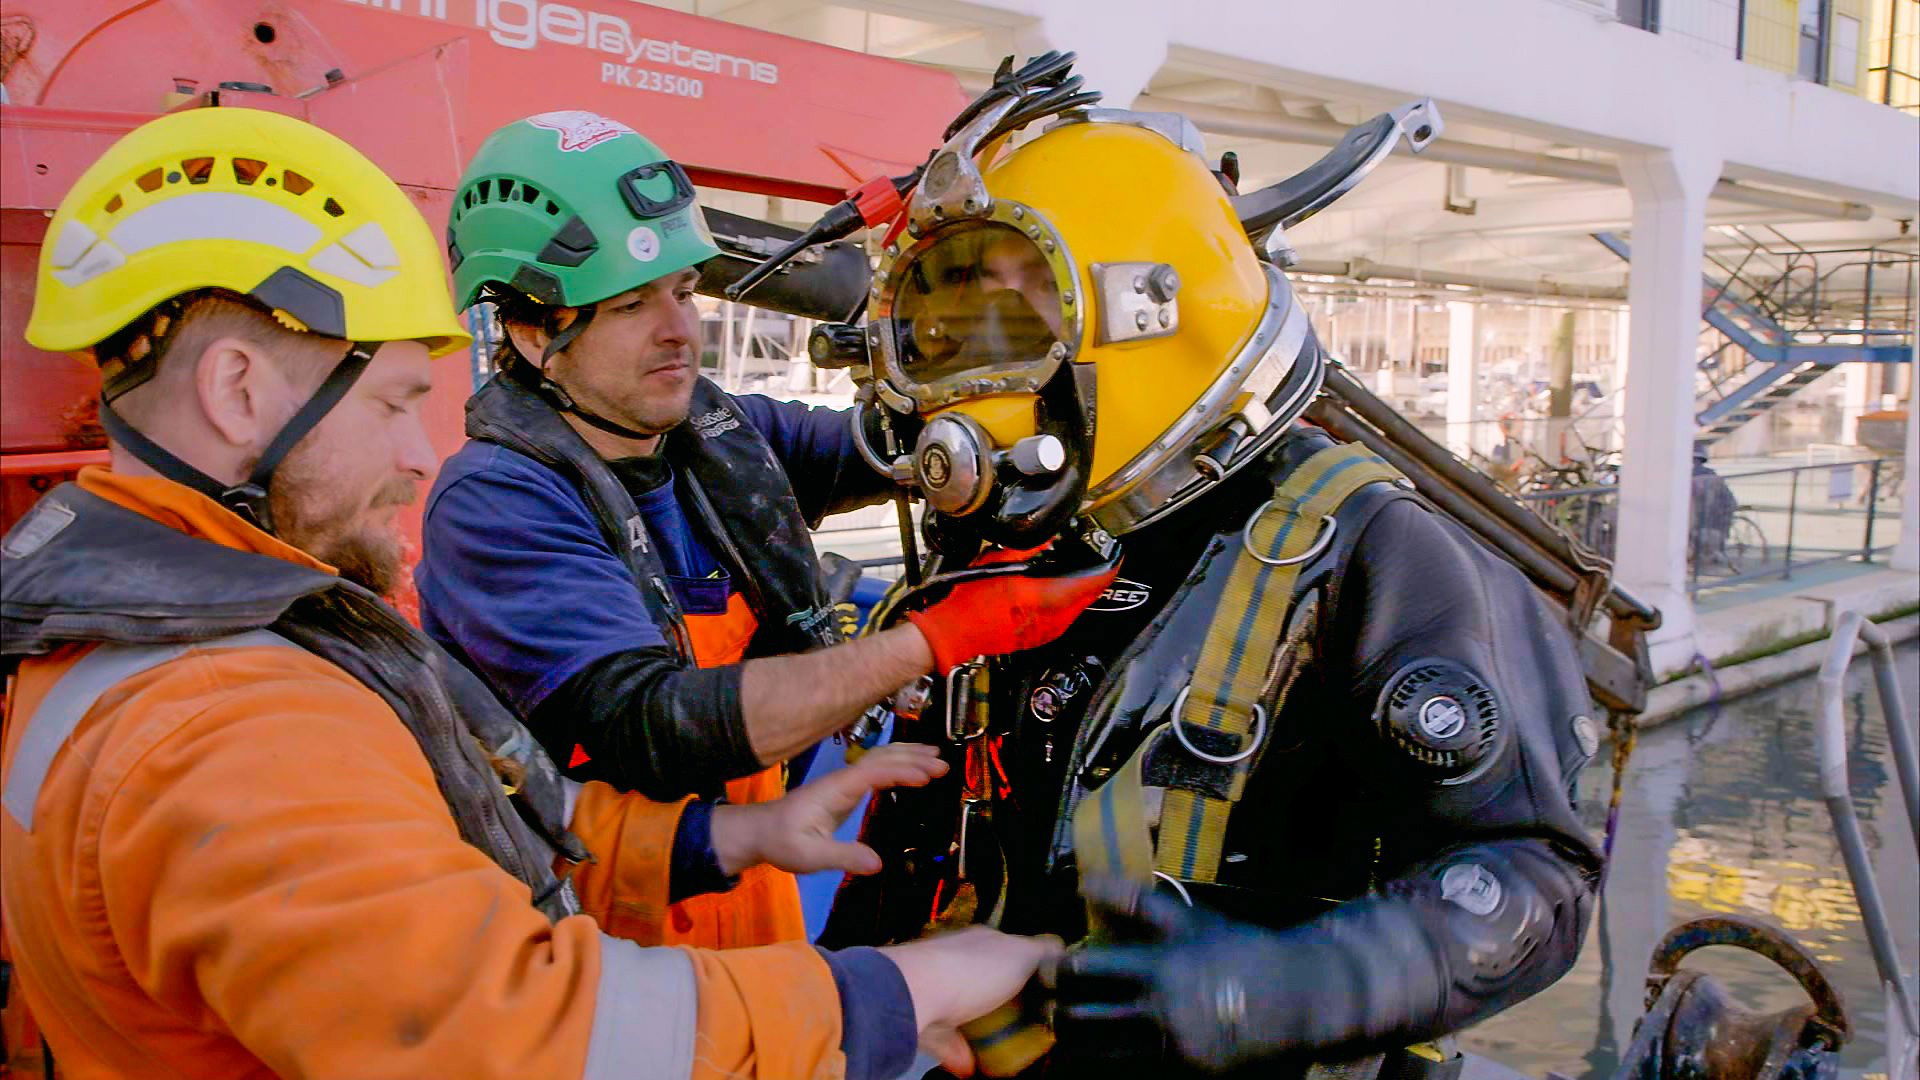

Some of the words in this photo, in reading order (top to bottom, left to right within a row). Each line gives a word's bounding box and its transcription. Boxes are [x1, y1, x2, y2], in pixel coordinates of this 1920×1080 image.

[600, 31, 778, 84] systems
[602, 63, 632, 87] PK
[636, 68, 704, 99] 23500
[1096, 588, 1141, 603] REE
